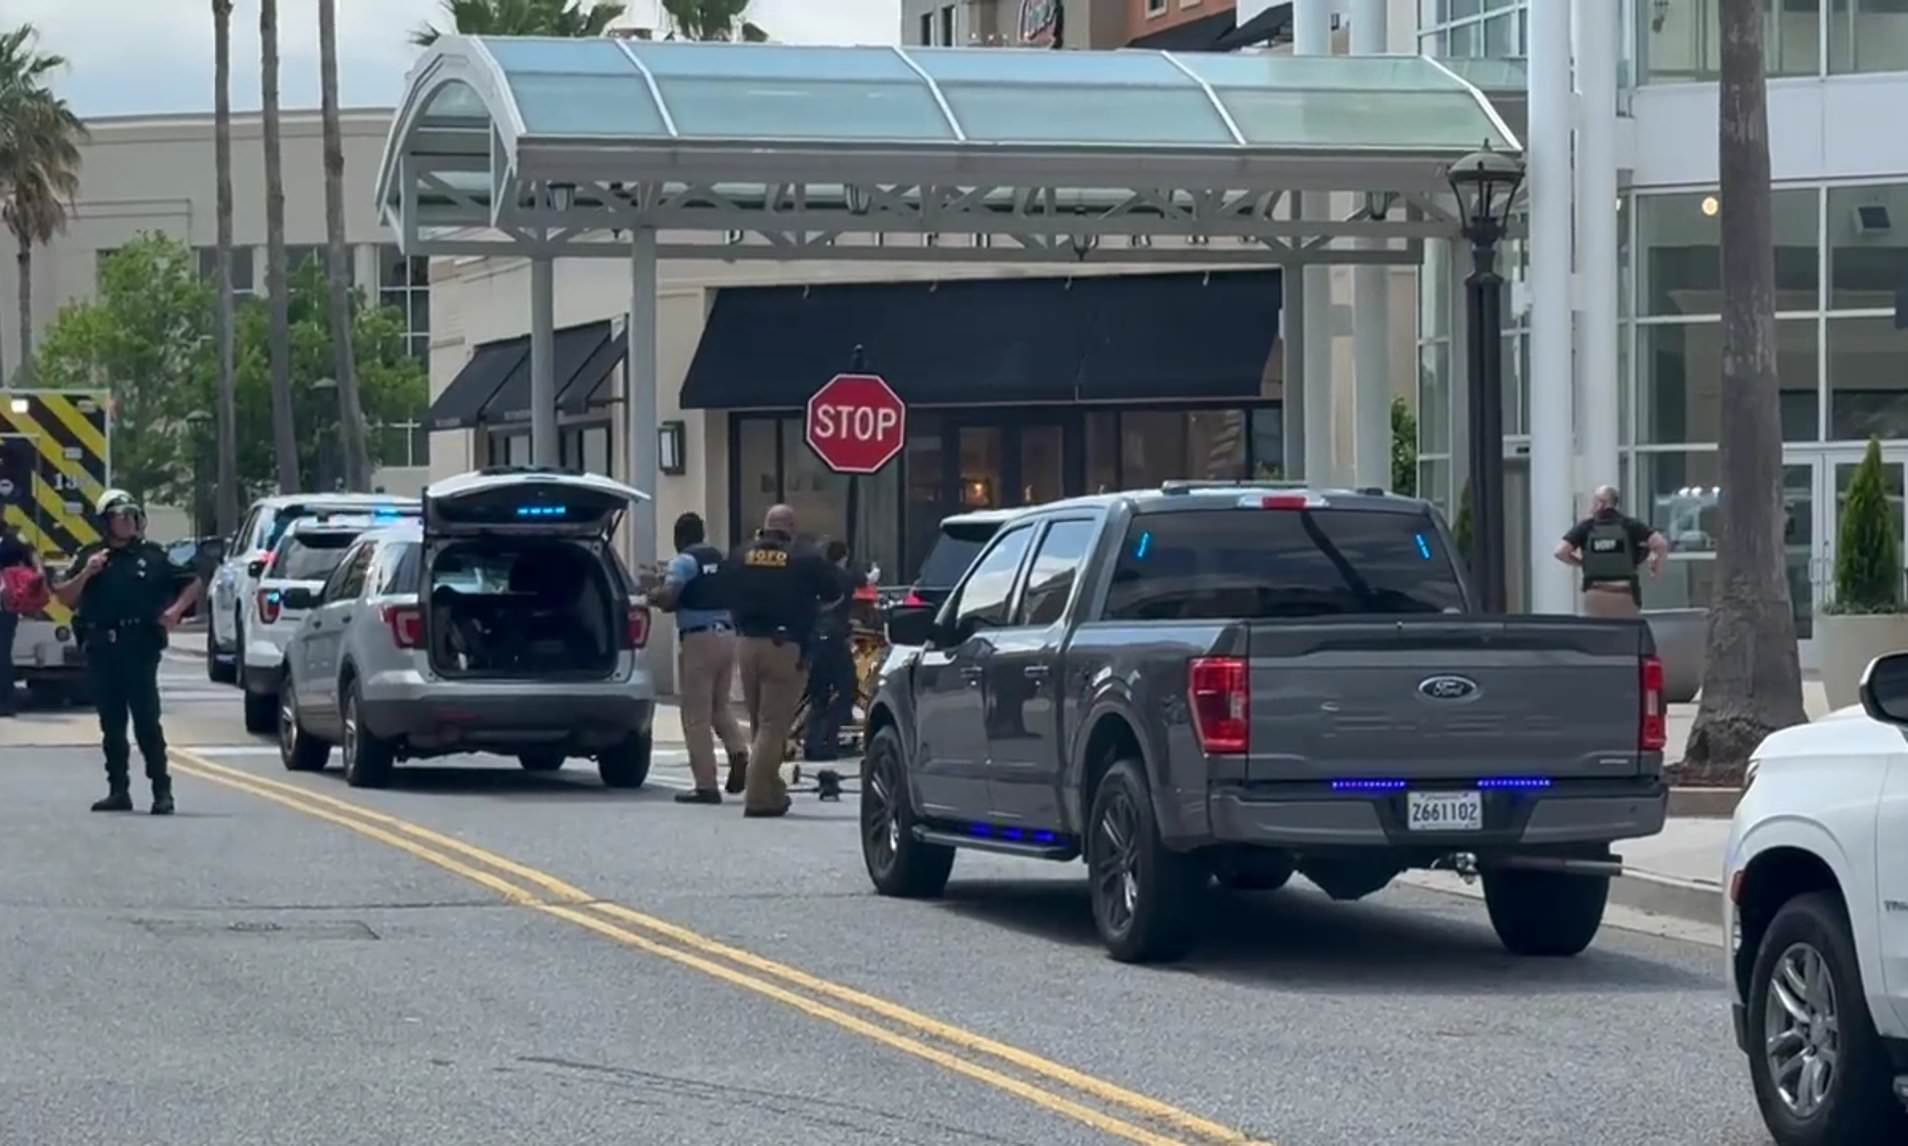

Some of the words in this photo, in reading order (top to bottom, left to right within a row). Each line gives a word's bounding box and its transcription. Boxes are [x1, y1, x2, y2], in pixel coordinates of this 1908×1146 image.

[815, 404, 897, 441] STOP
[1432, 681, 1464, 697] Ford
[1413, 802, 1478, 822] Z661102
